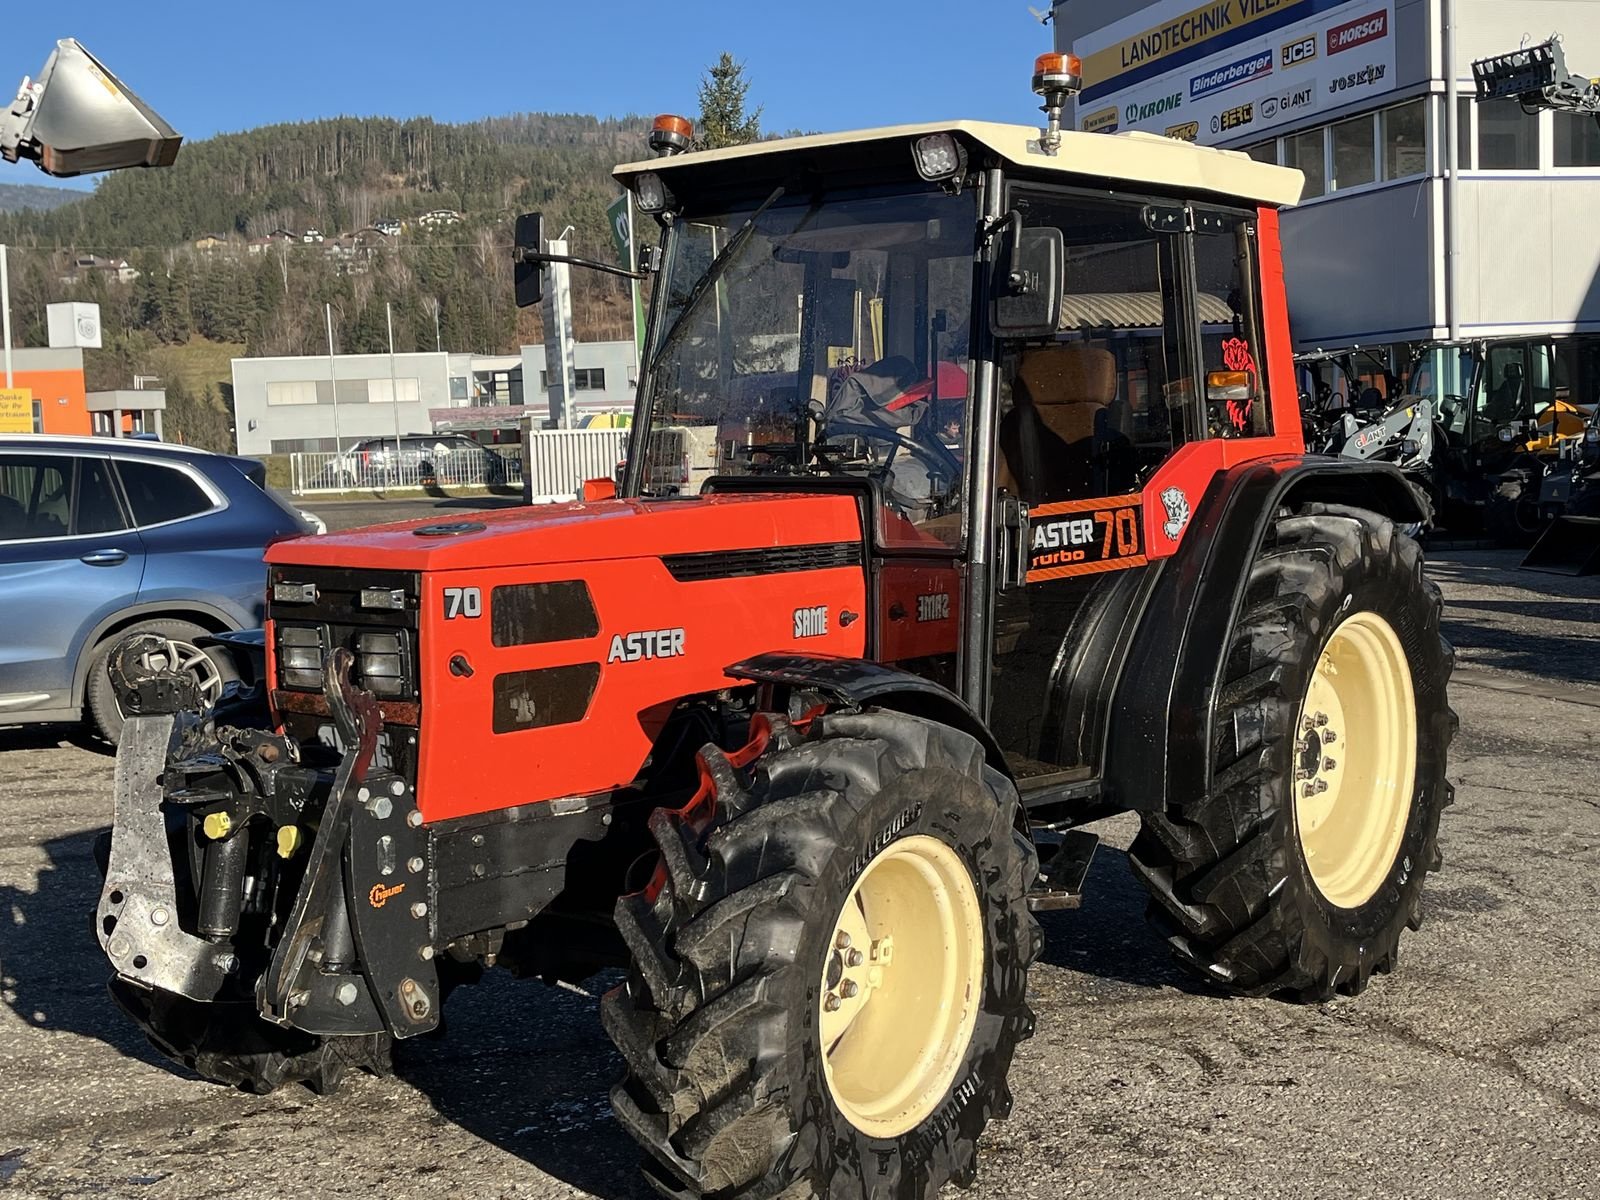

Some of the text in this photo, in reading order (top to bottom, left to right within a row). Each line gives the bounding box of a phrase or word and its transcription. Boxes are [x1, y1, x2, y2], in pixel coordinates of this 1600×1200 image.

[1121, 0, 1289, 68] LANDTECHNIK VIL
[1338, 17, 1384, 46] HORSCH
[1282, 38, 1315, 65] JCB
[1192, 54, 1271, 94] Binderberger
[1138, 91, 1182, 121] KRONE
[1031, 507, 1138, 559] ASTER 70
[443, 586, 482, 620] 70
[793, 605, 828, 639] SAME
[607, 627, 686, 665] ASTER
[374, 883, 406, 902] hauer
